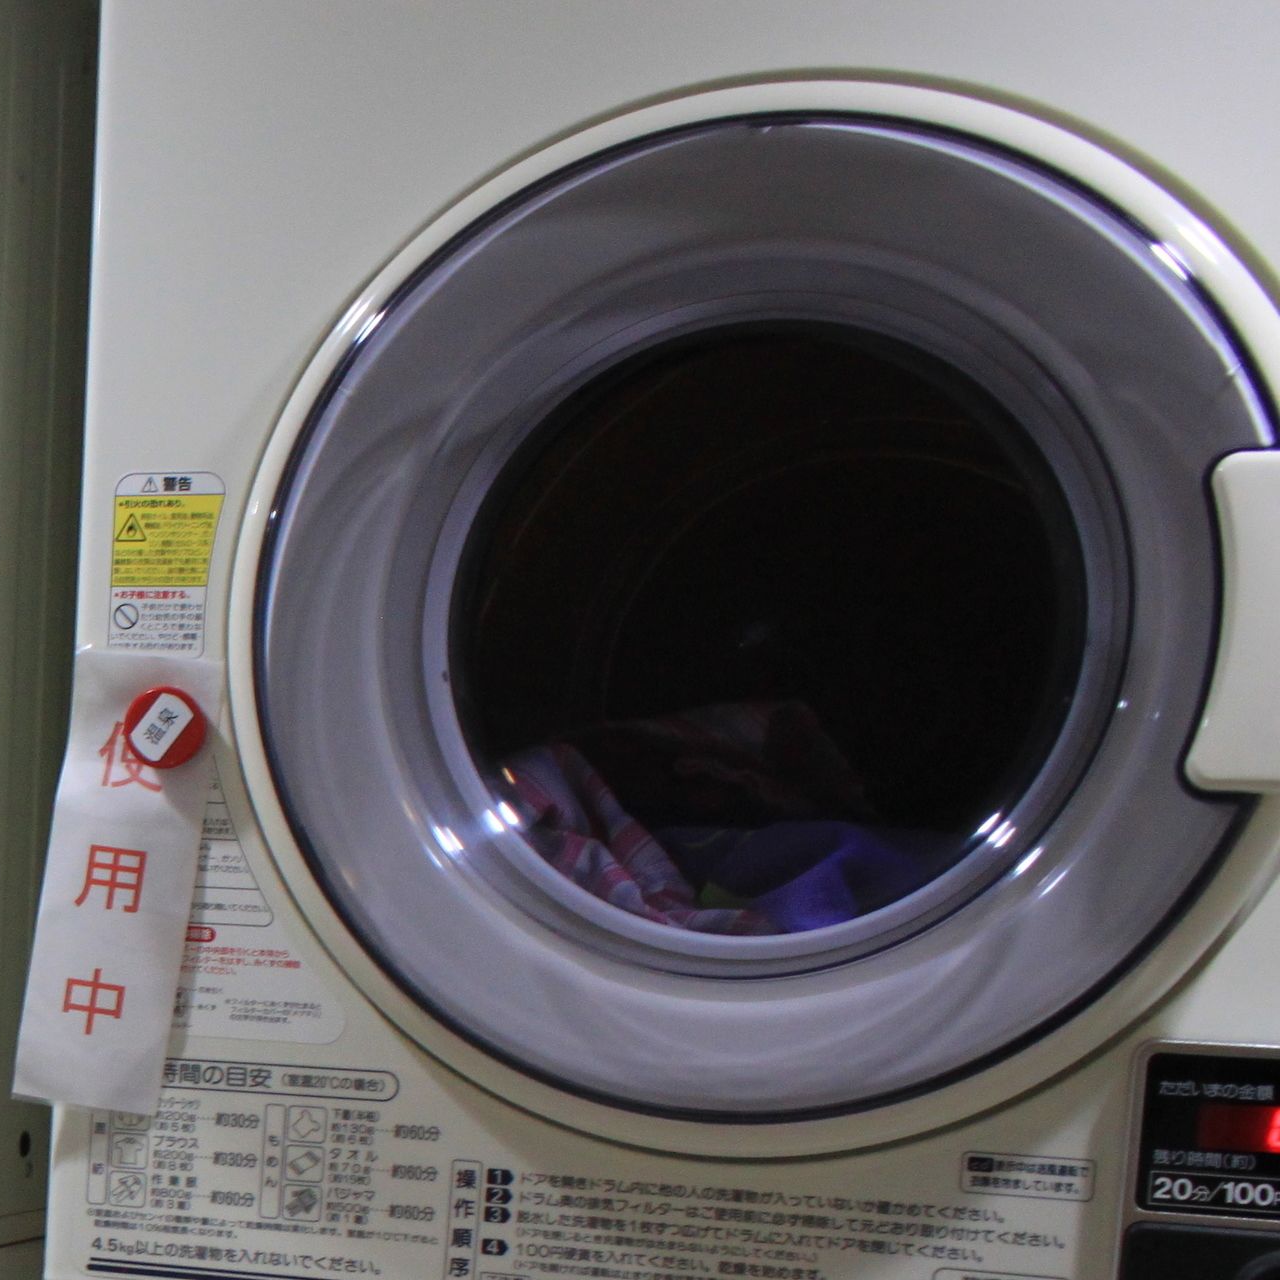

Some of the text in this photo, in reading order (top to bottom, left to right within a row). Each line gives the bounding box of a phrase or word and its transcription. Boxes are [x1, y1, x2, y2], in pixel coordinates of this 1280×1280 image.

[143, 706, 179, 746] 温泉
[1158, 1080, 1275, 1101] ただいまの金額
[448, 1168, 476, 1278] 操作順序
